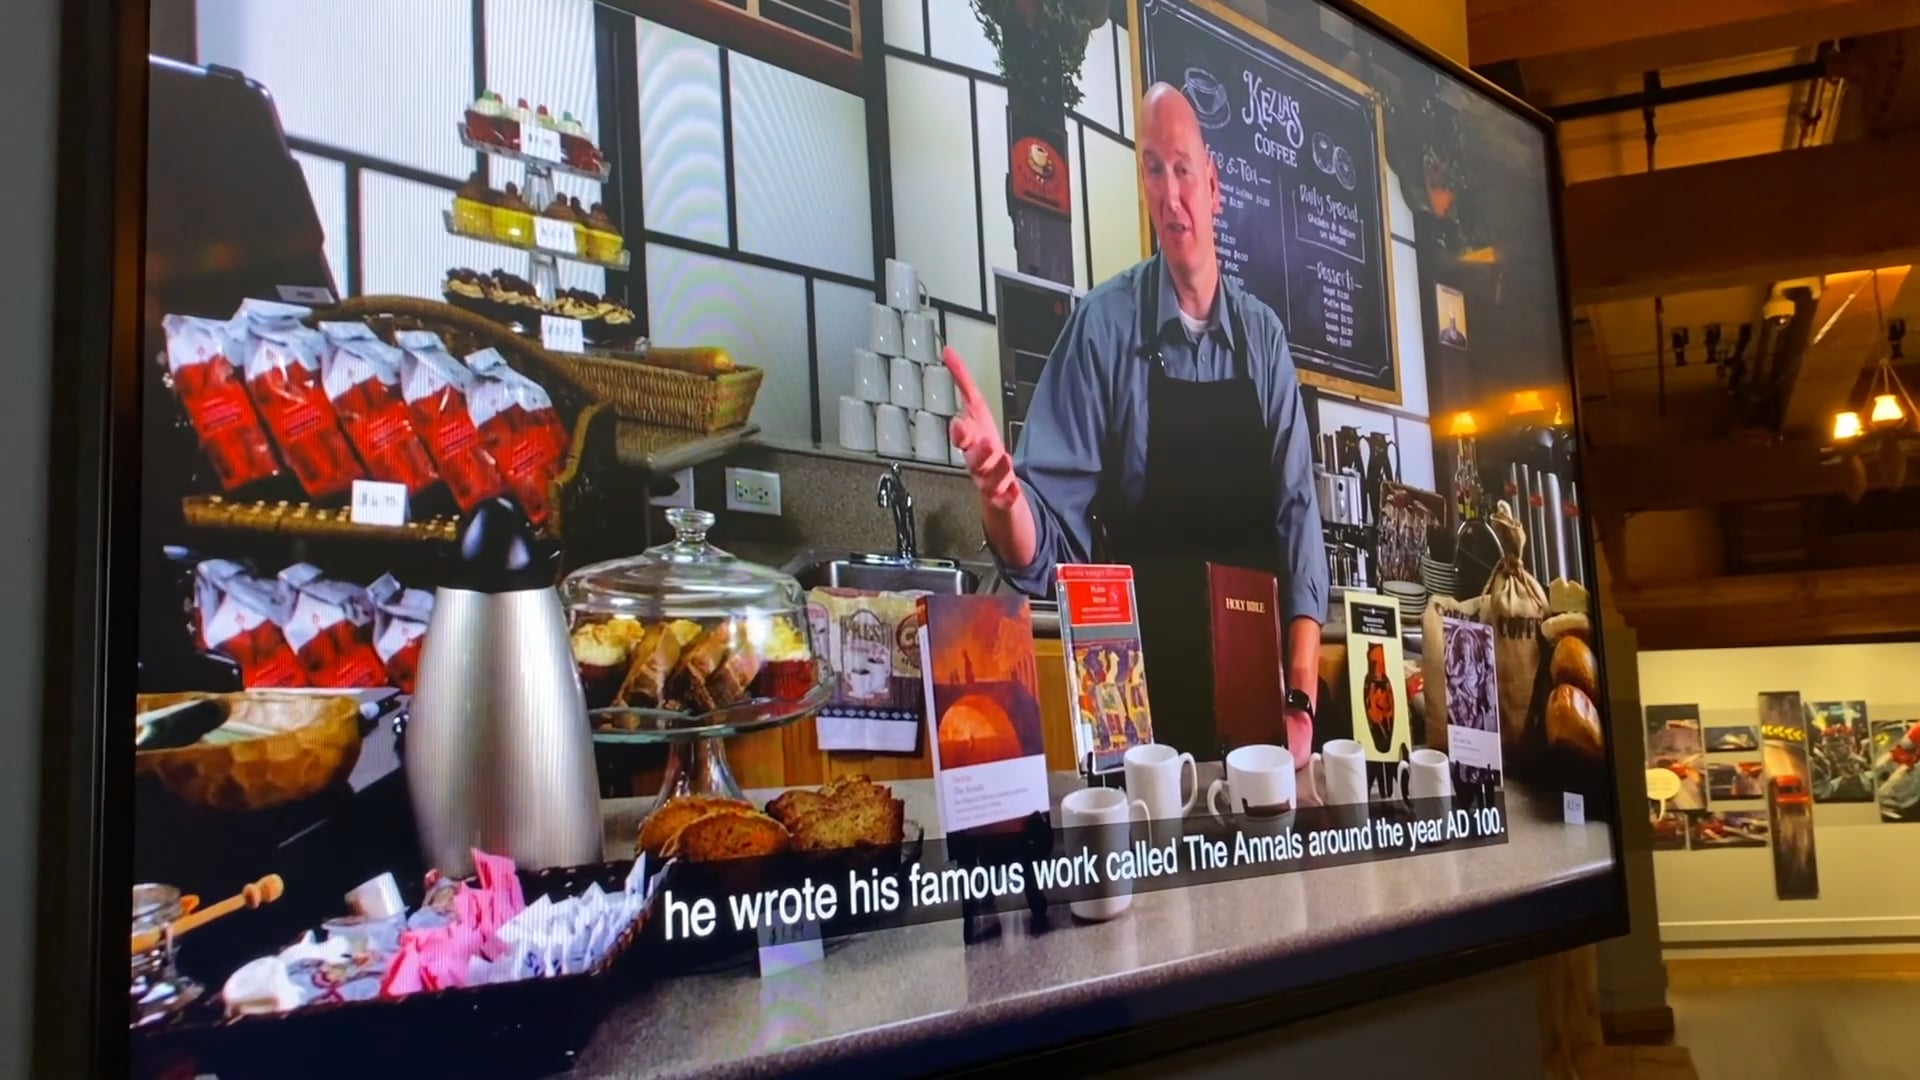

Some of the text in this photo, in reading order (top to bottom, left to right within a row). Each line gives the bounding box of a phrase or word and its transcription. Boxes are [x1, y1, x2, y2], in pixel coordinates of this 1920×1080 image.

[1254, 132, 1298, 168] COFFEE
[1299, 184, 1359, 223] Daily Special
[1316, 261, 1355, 291] Desserts
[1225, 597, 1266, 613] HOLY BIBLE
[664, 807, 1507, 941] he wrote his famous work called The Annals around the year AD 100.
